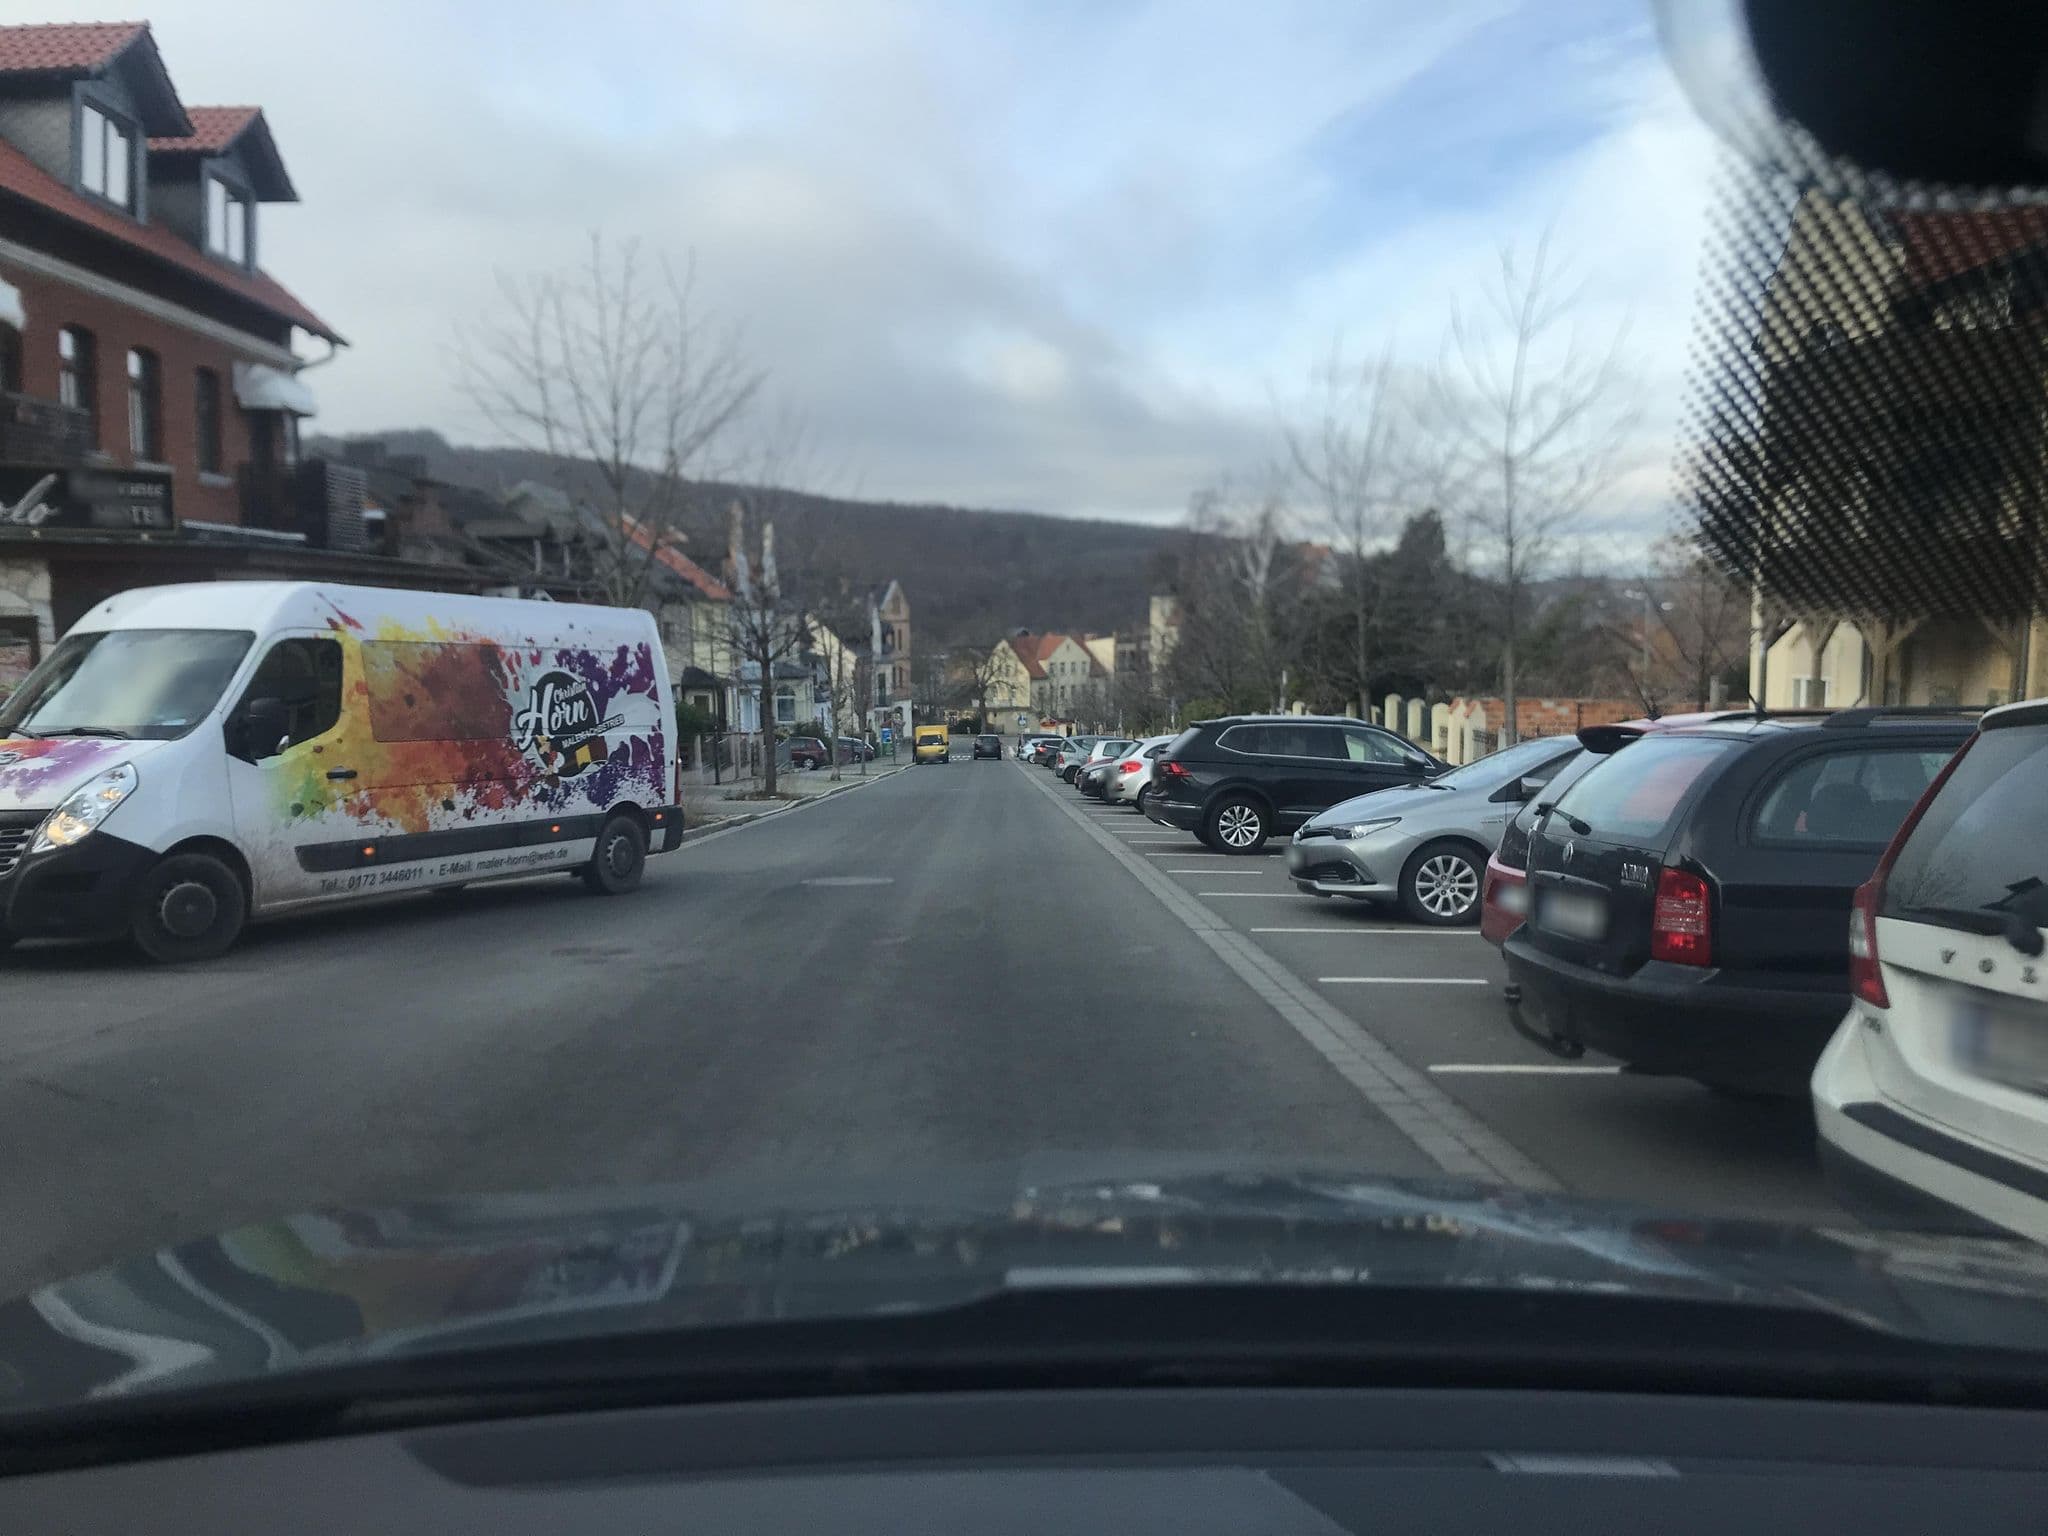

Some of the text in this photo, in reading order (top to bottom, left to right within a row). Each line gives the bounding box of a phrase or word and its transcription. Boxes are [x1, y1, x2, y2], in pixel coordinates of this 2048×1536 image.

[553, 681, 587, 704] Christian
[517, 683, 589, 748] Horn
[347, 873, 376, 889] 0172
